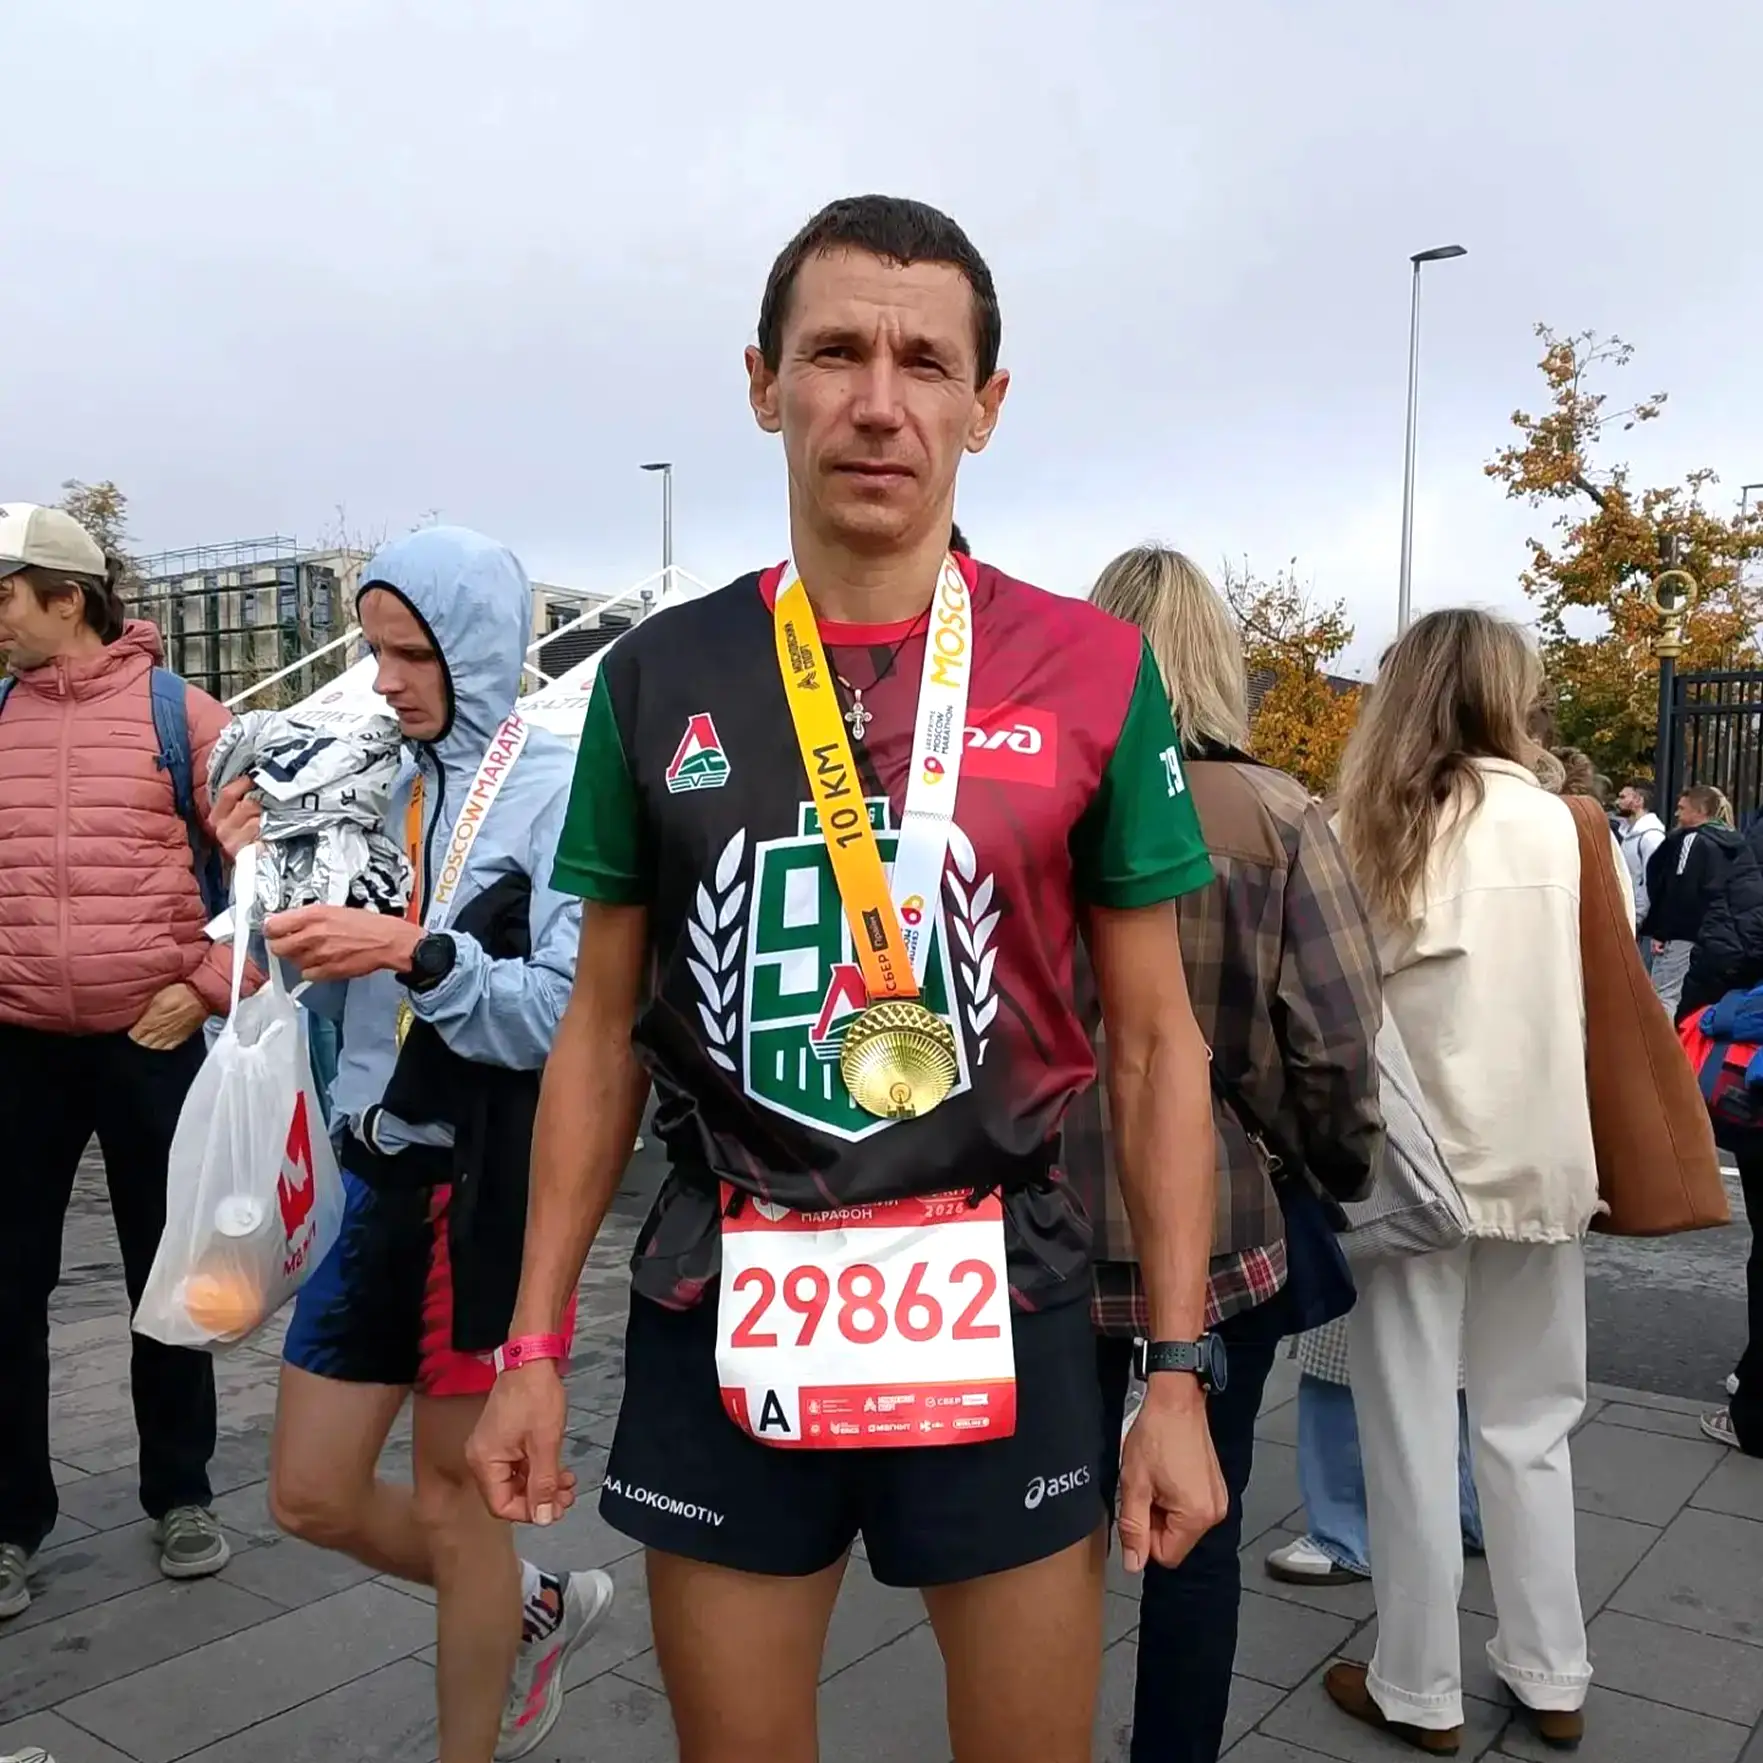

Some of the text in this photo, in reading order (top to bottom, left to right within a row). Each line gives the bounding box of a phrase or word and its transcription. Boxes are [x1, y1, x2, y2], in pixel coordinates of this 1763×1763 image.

[930, 552, 966, 688] MOSCO
[933, 712, 944, 753] MOSCOW
[941, 705, 954, 754] MARATHON
[435, 711, 525, 904] MOSCOW MARATH
[830, 808, 863, 849] 10
[878, 954, 897, 991] СБЕР
[925, 1202, 965, 1218] 2026
[731, 1259, 1001, 1348] 29862
[1047, 1465, 1090, 1497] asics
[625, 1484, 724, 1527] LOKOMOTIV
